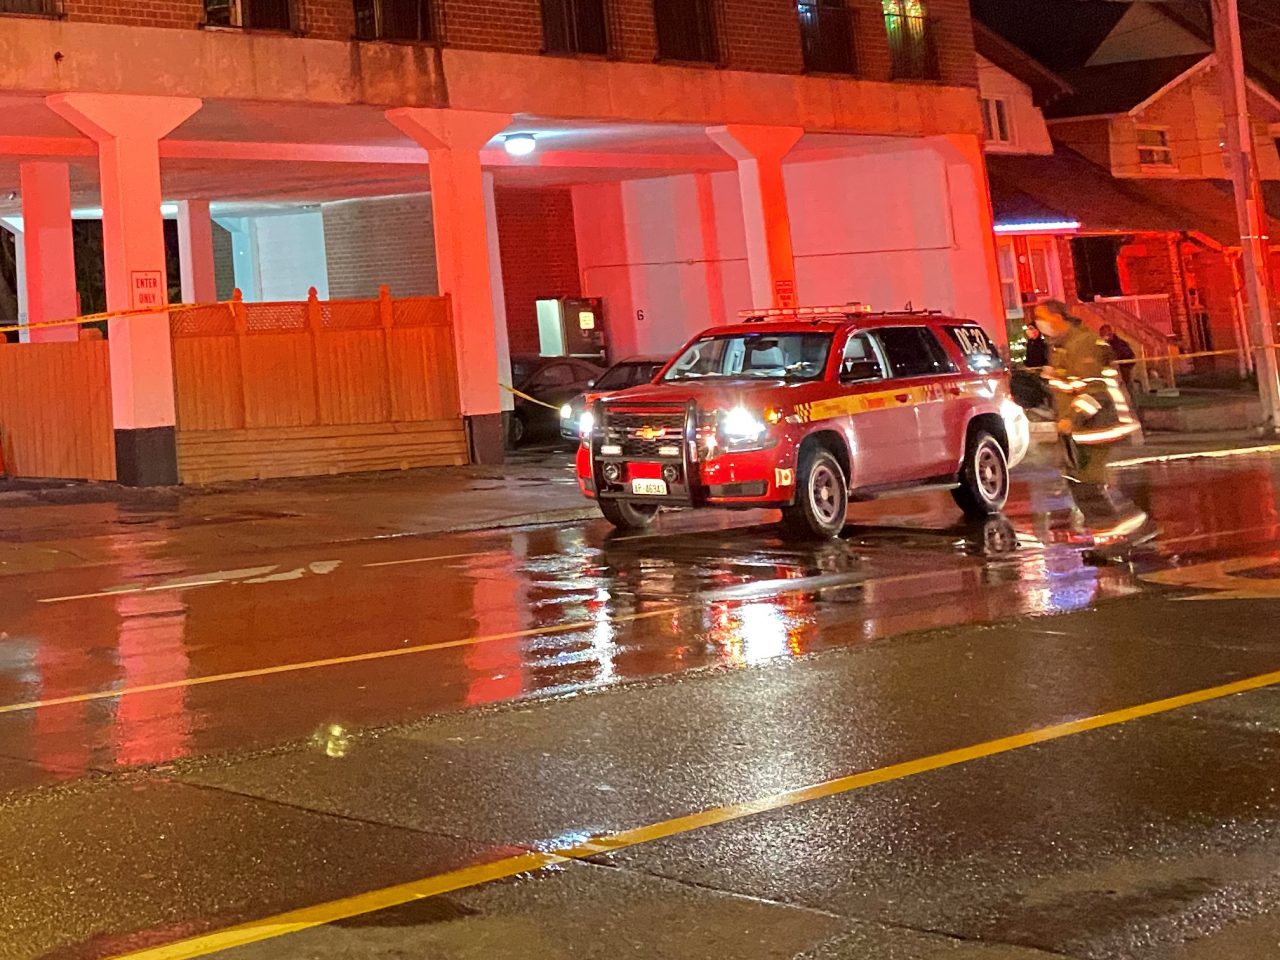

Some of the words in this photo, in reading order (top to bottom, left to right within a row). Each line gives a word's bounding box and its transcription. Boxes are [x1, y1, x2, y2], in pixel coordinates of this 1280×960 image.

[136, 278, 157, 289] ENTER
[139, 293, 156, 304] ONLY
[636, 309, 645, 321] 6
